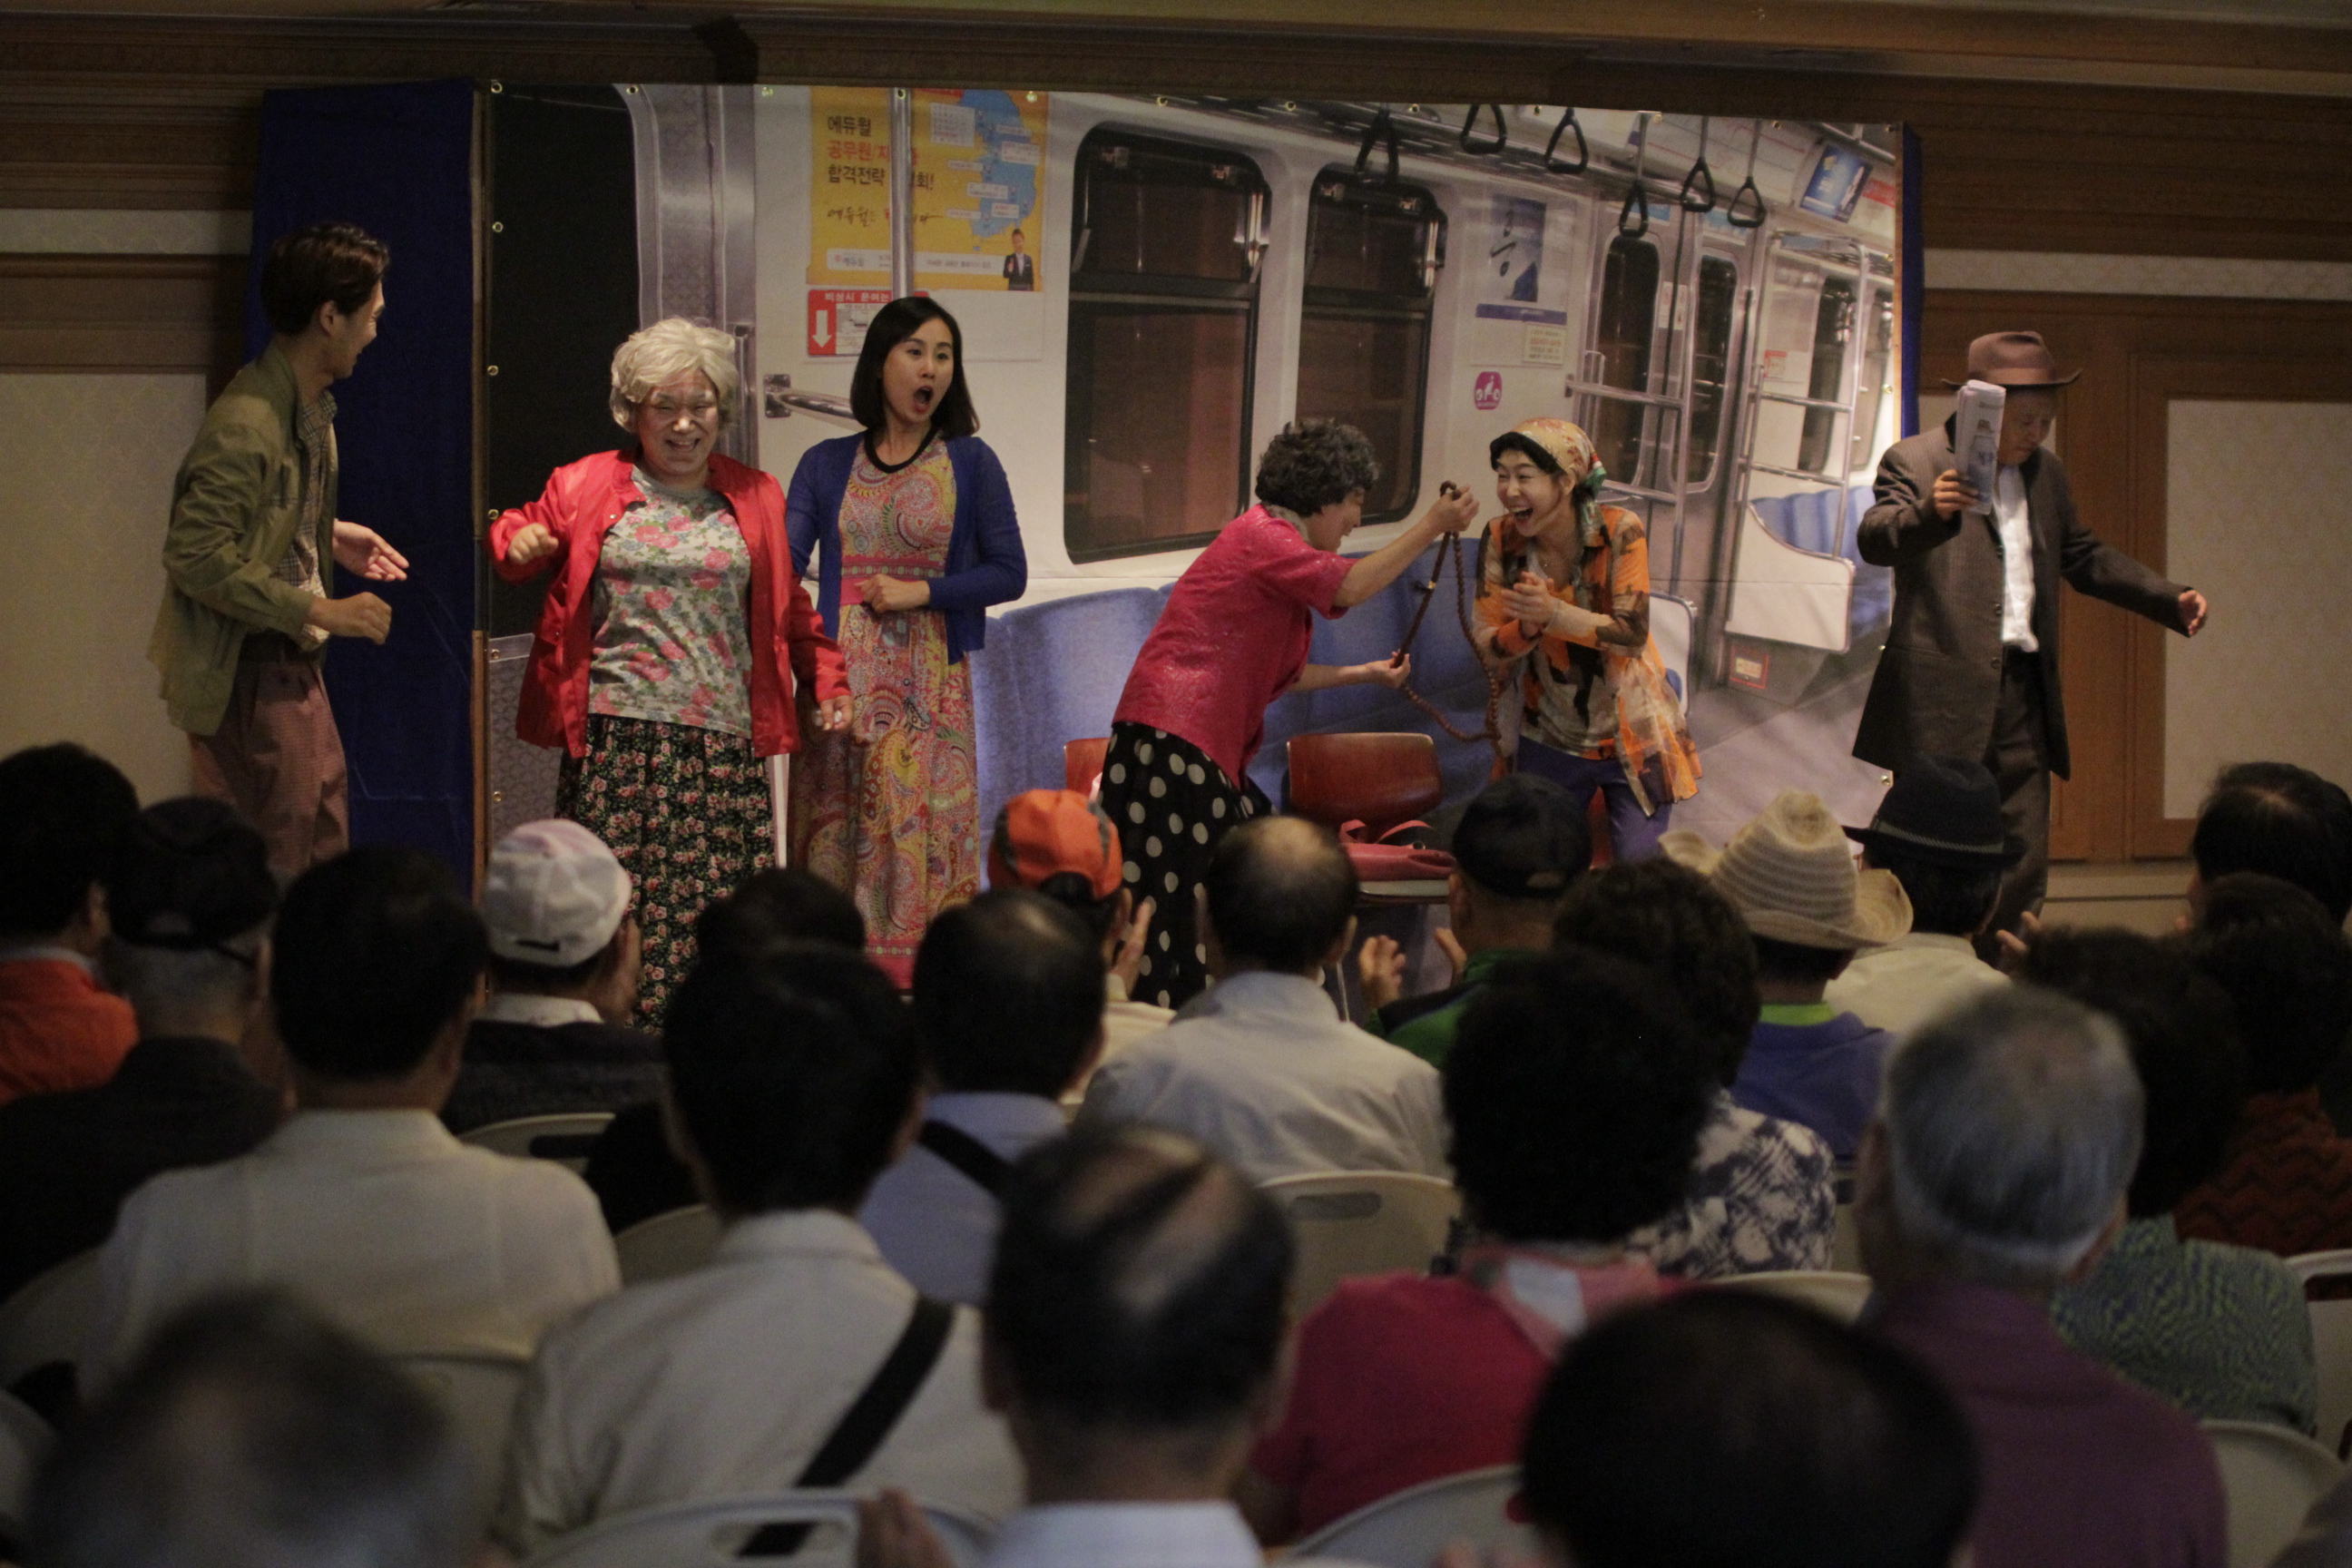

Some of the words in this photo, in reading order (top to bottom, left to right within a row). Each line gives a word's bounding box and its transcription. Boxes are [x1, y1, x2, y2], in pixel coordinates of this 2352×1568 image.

[828, 115, 871, 137] 에듀윌
[828, 139, 872, 162] 공무원
[828, 164, 886, 187] 합격전략
